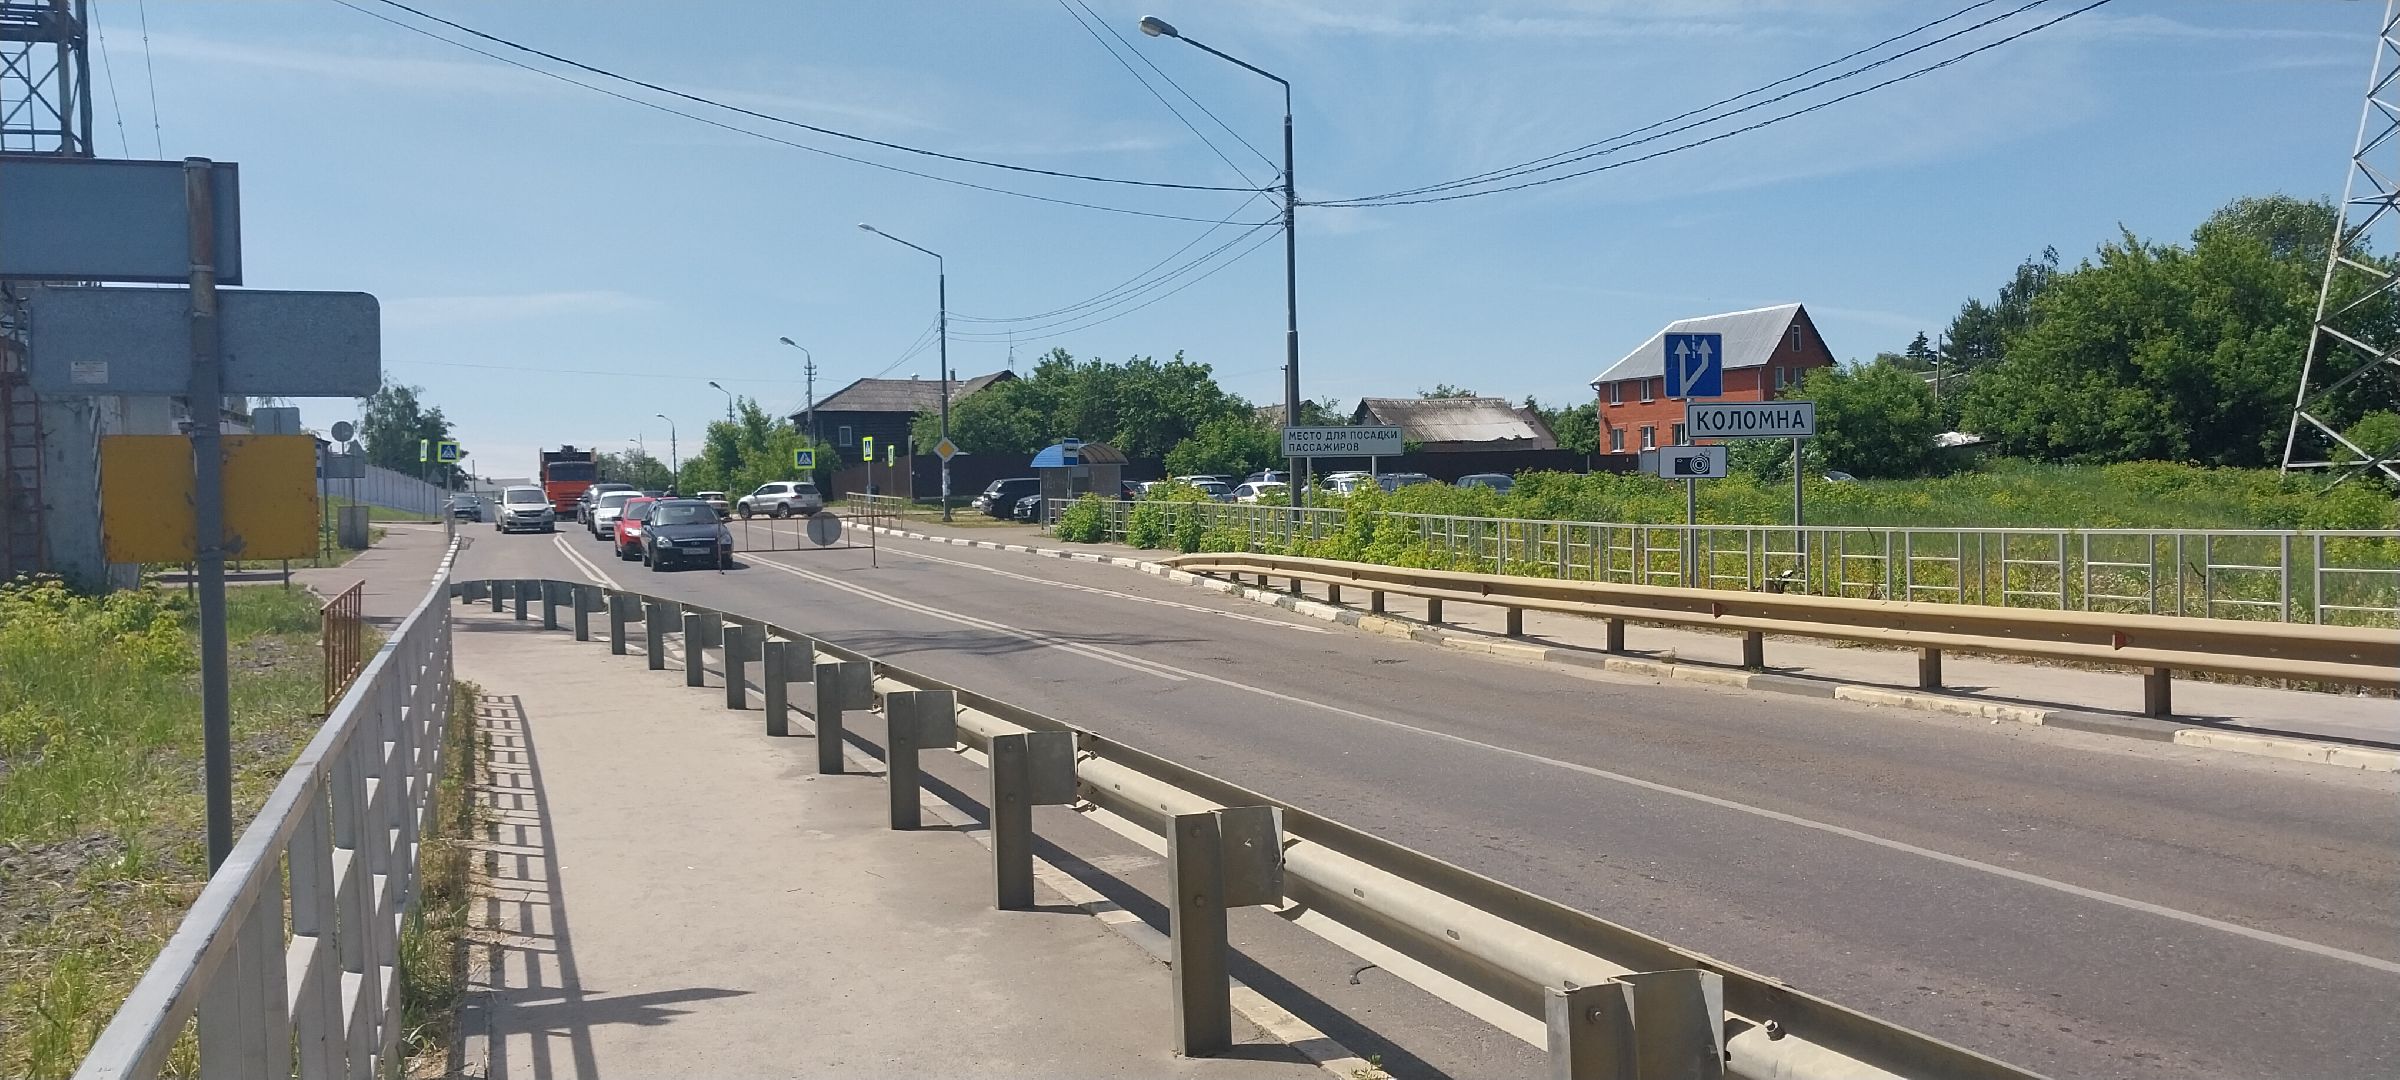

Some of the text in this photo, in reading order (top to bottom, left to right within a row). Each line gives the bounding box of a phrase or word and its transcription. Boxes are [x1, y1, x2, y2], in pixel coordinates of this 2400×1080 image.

[1697, 410, 1805, 430] КОЛОМНА
[1288, 430, 1398, 441] МЕСТО ДЛЯ ПОСАДКИ
[1288, 442, 1359, 452] ПАССАЖИРОВ
